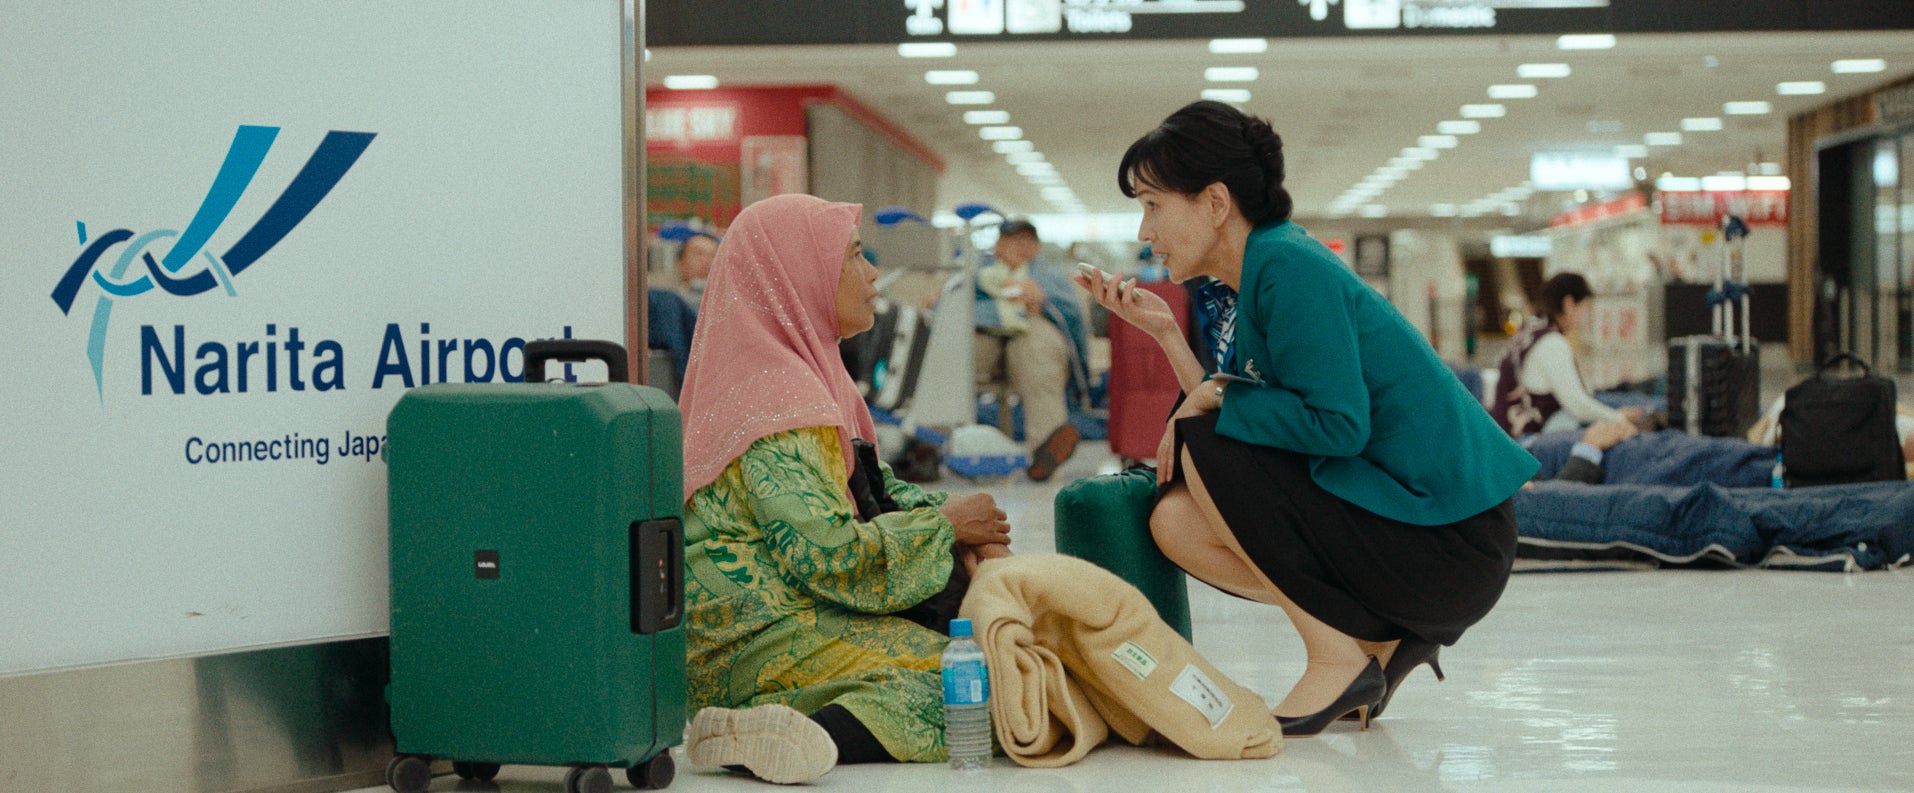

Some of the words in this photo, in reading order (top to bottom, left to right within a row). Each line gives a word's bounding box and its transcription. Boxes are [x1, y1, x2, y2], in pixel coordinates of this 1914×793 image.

[140, 323, 346, 396] Narita
[372, 322, 578, 390] Airpot
[185, 432, 330, 465] Connecting
[338, 430, 388, 463] Jap
